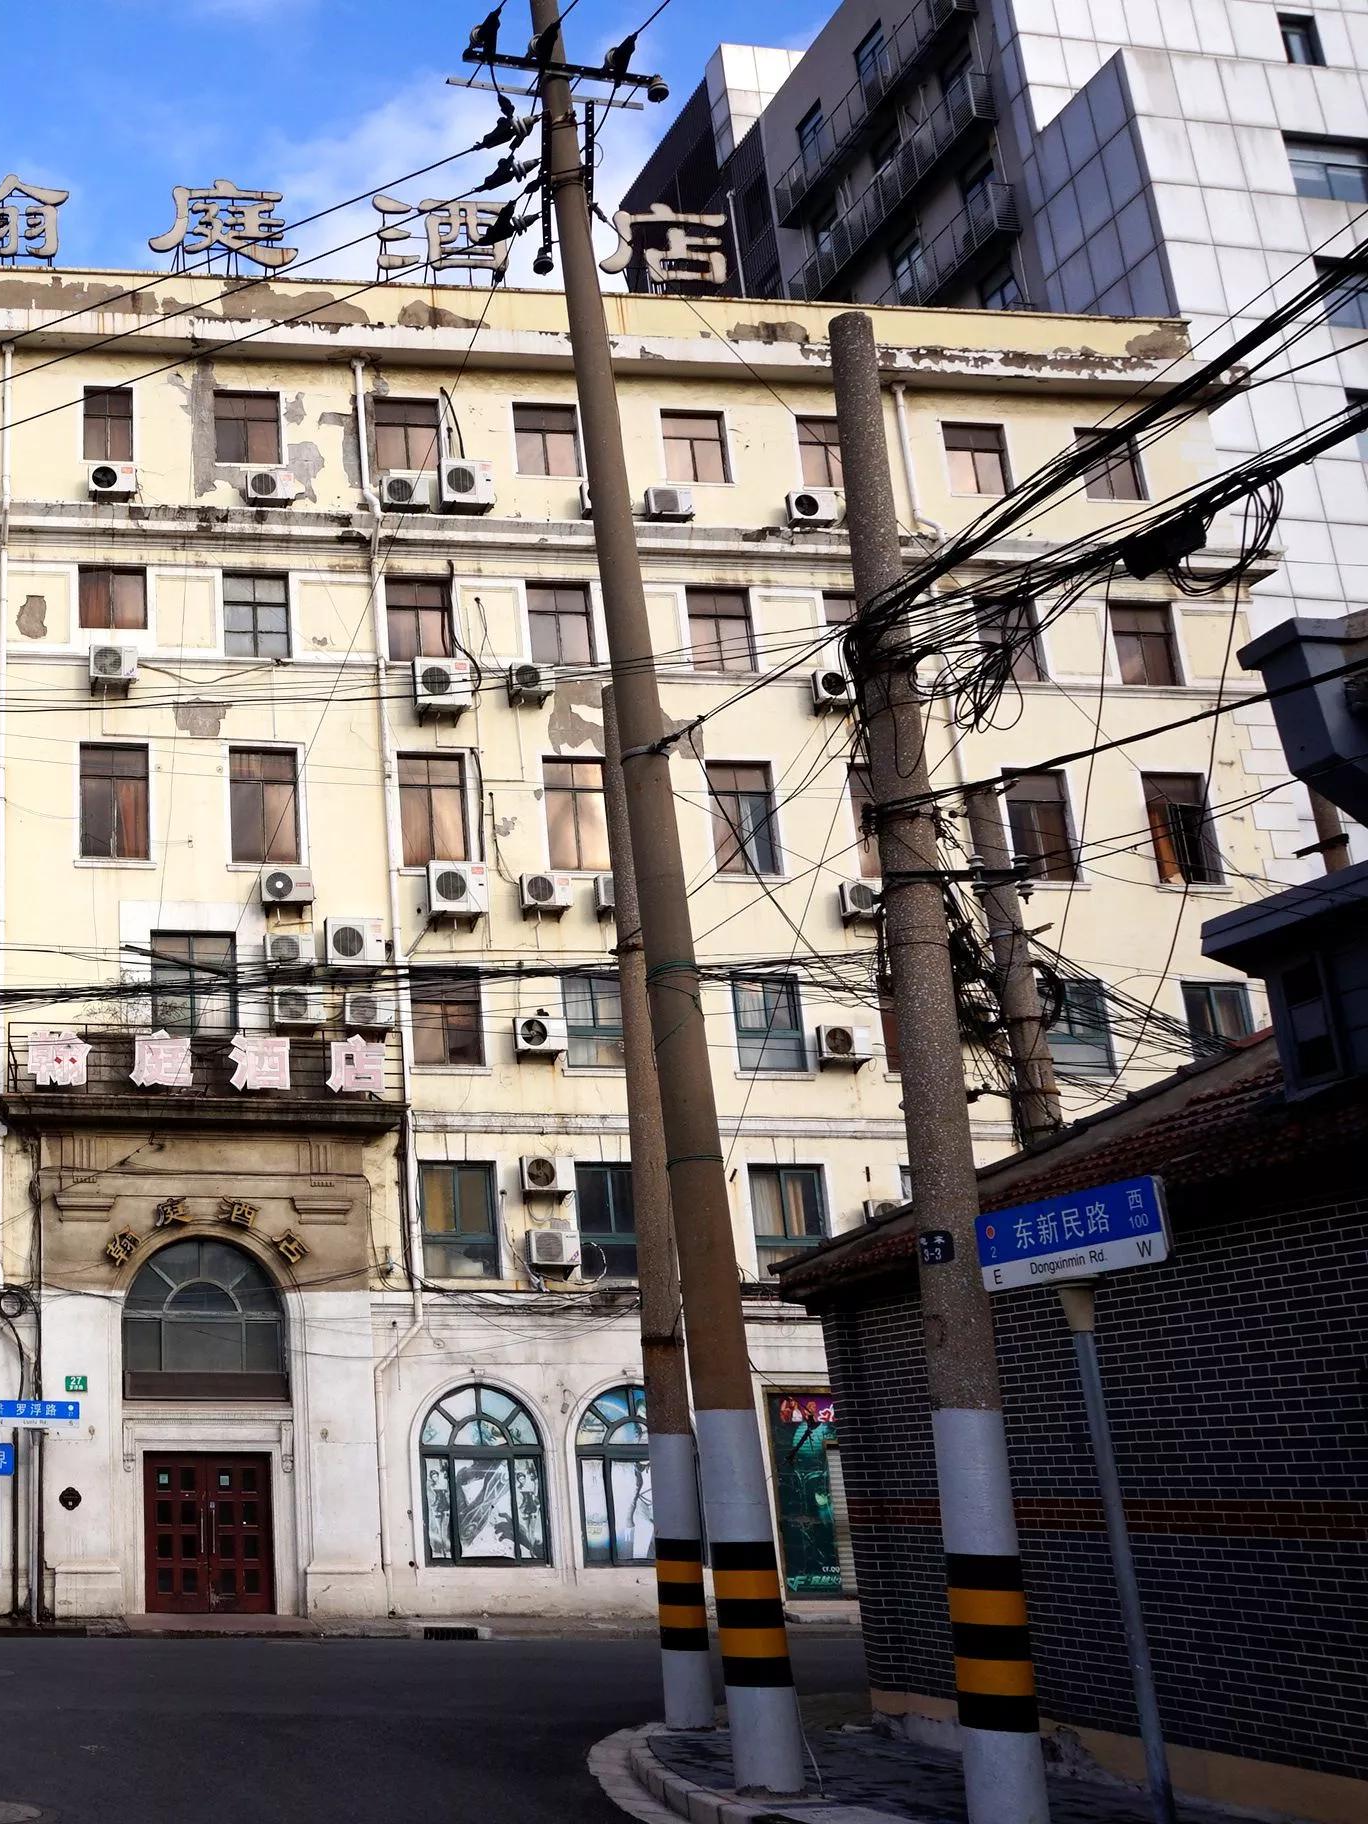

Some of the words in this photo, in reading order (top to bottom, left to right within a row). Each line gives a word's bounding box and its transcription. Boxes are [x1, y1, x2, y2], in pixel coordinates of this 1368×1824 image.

[27, 1029, 386, 1093] 翰庭酒店
[1126, 1188, 1144, 1211] 西
[1013, 1202, 1110, 1250] 东新民路
[1129, 1213, 1149, 1229] 100
[991, 1246, 997, 1258] 2
[1136, 1240, 1152, 1258] W
[1030, 1255, 1085, 1275] Dongxinmin
[1088, 1251, 1107, 1264] Rd.
[993, 1269, 1002, 1285] E
[70, 1376, 82, 1386] 27
[16, 1403, 56, 1416] 罗浮路
